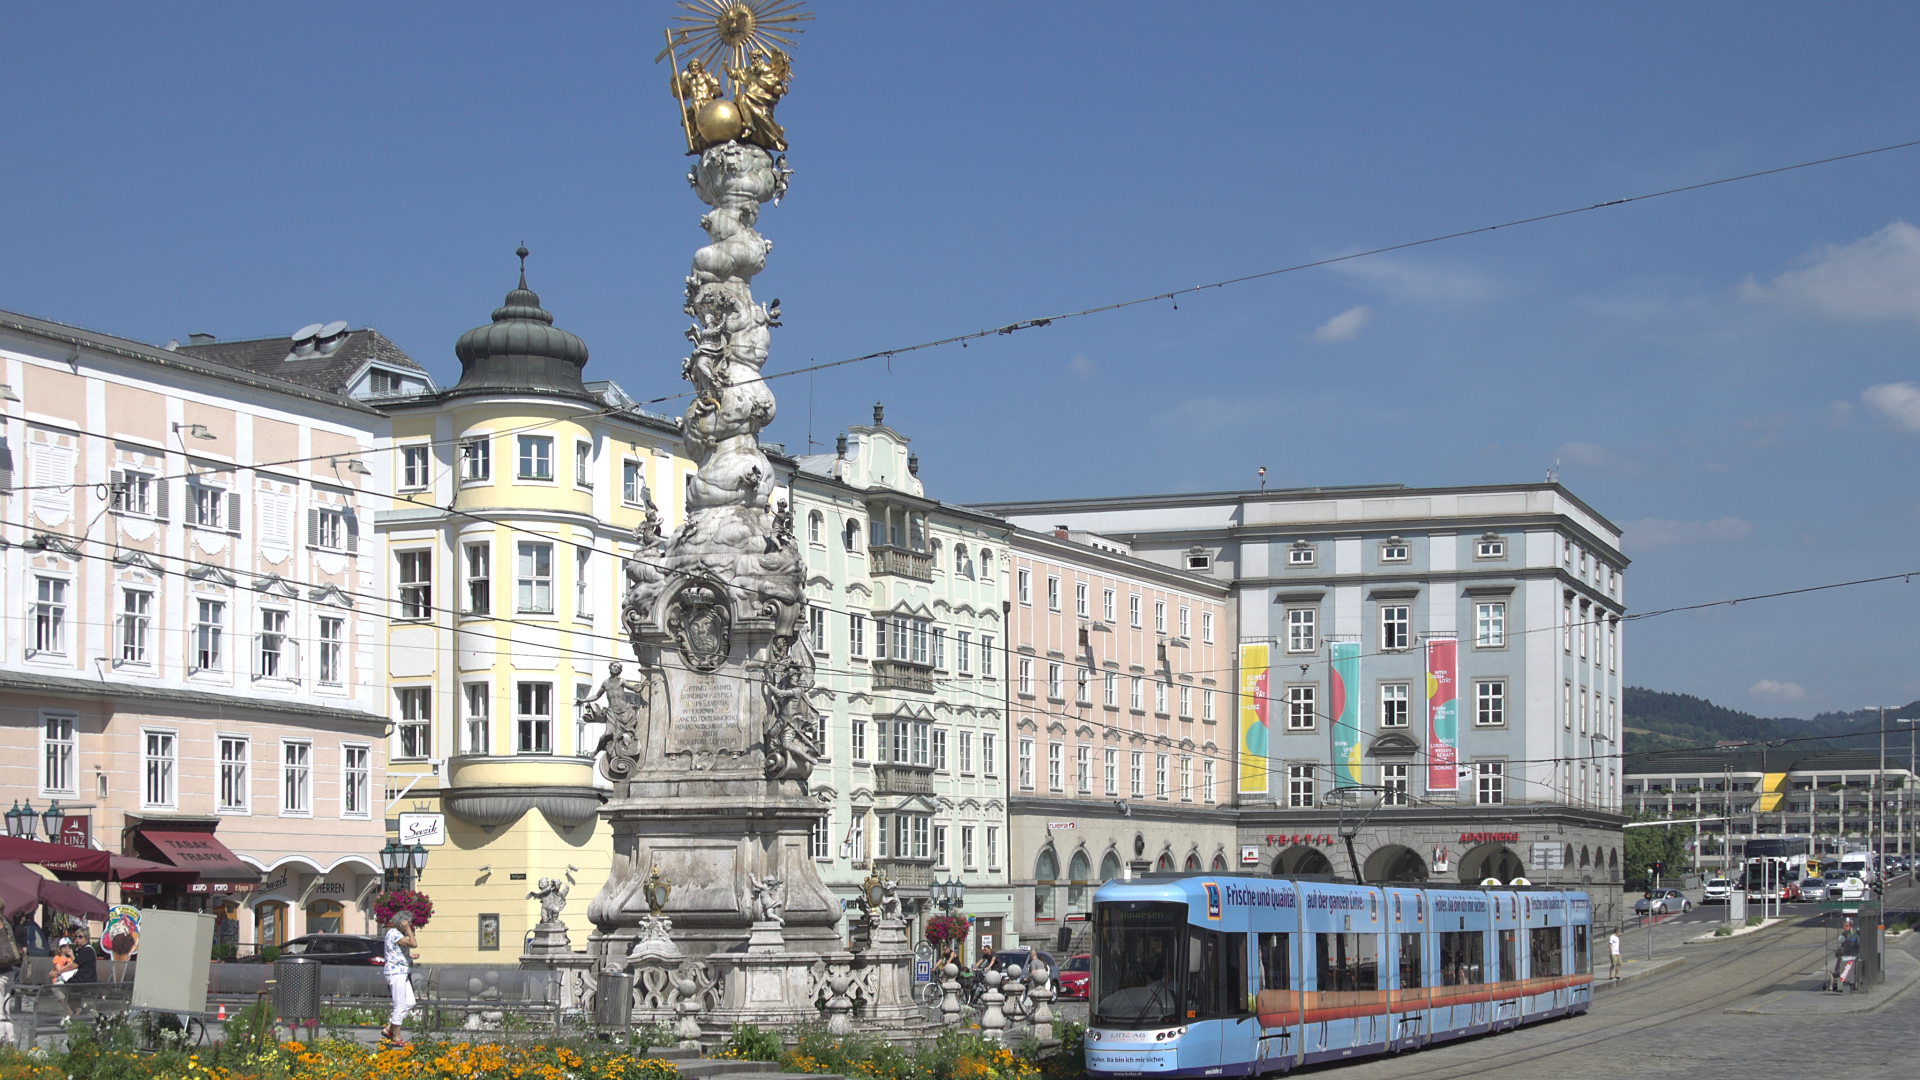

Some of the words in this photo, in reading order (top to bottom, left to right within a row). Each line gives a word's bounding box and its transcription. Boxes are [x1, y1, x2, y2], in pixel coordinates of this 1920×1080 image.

[64, 836, 86, 846] LINZ
[1267, 834, 1334, 844] TEXTIL
[1460, 832, 1518, 842] APOTHEKE
[166, 840, 214, 850] TABAK
[177, 852, 228, 862] TRAFIK
[316, 882, 344, 894] HERREN
[1226, 883, 1256, 906] Frische
[1257, 886, 1270, 906] und
[1271, 887, 1296, 910] Qualität
[1308, 890, 1317, 908] auf
[1318, 890, 1328, 910] der
[1329, 894, 1349, 914] ganzen
